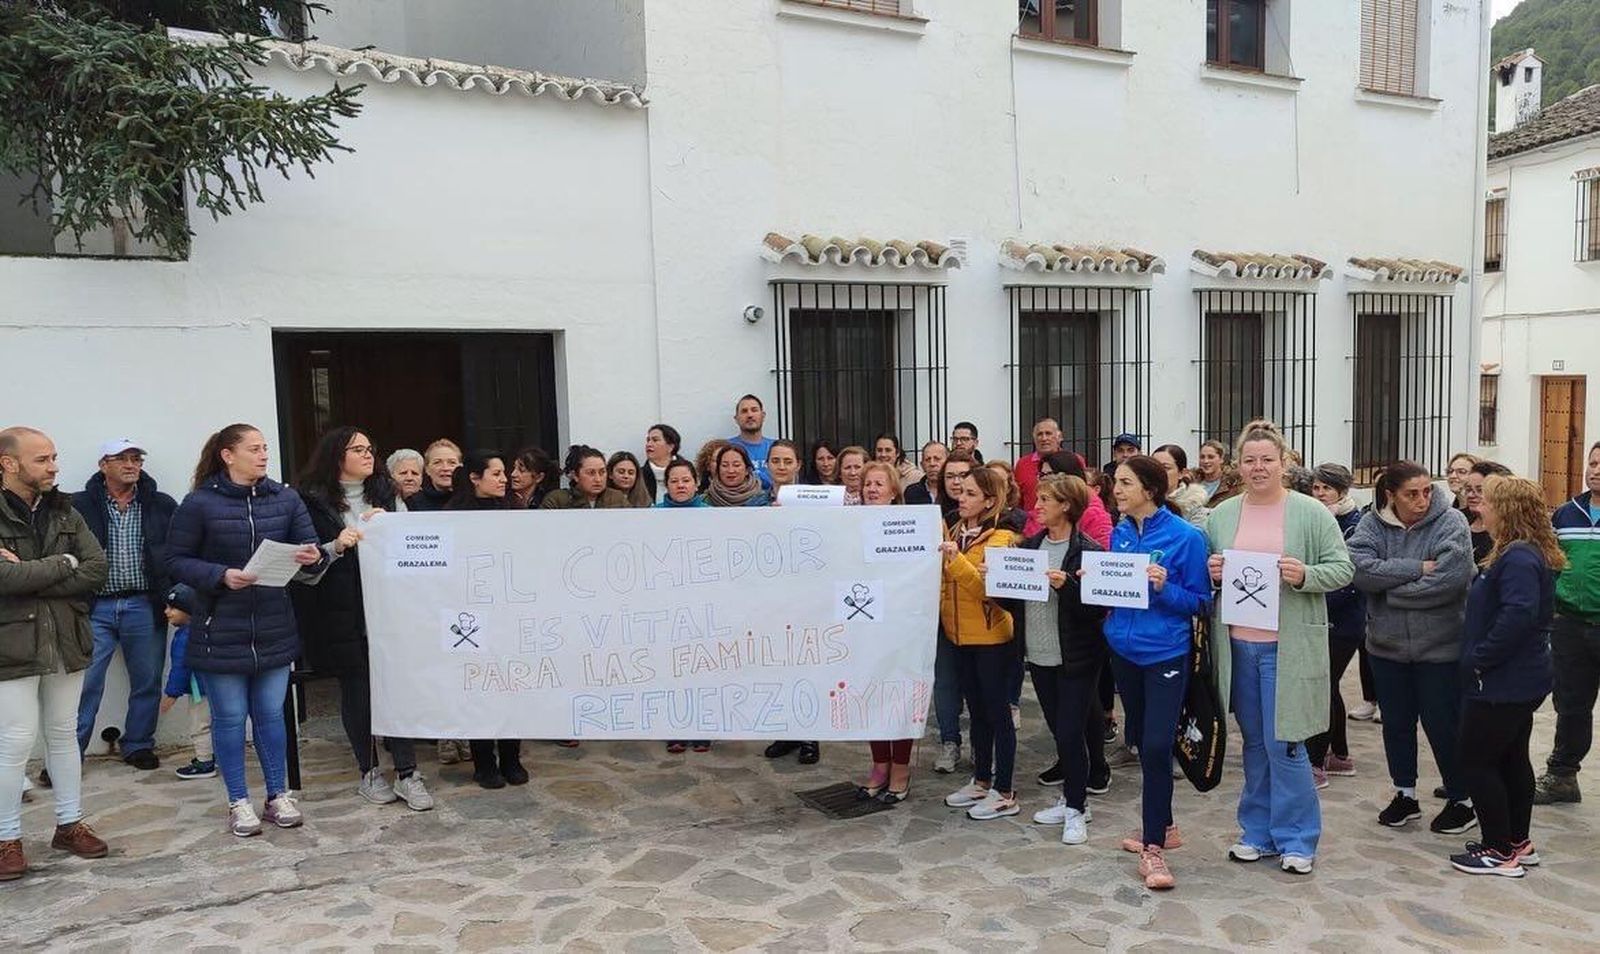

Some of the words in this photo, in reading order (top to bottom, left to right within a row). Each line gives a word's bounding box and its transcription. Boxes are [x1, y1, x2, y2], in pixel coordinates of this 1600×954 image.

[875, 545, 926, 554] GRAZALEMA
[397, 560, 448, 568] GRAZALEMA
[1003, 555, 1035, 564] COMEDOR
[465, 551, 537, 605] EL
[562, 527, 827, 599] COMEDOR
[1004, 564, 1034, 572] ESCOLAR
[1100, 560, 1135, 569] COMEDOR
[1101, 569, 1133, 577] ESCOLAR
[996, 582, 1043, 592] GRAZALEMA
[1091, 588, 1141, 599] GRAZALEMA
[518, 616, 564, 654] ES
[463, 656, 562, 692] PARA
[583, 648, 656, 687] LAS
[572, 678, 820, 736] REFUERZO
